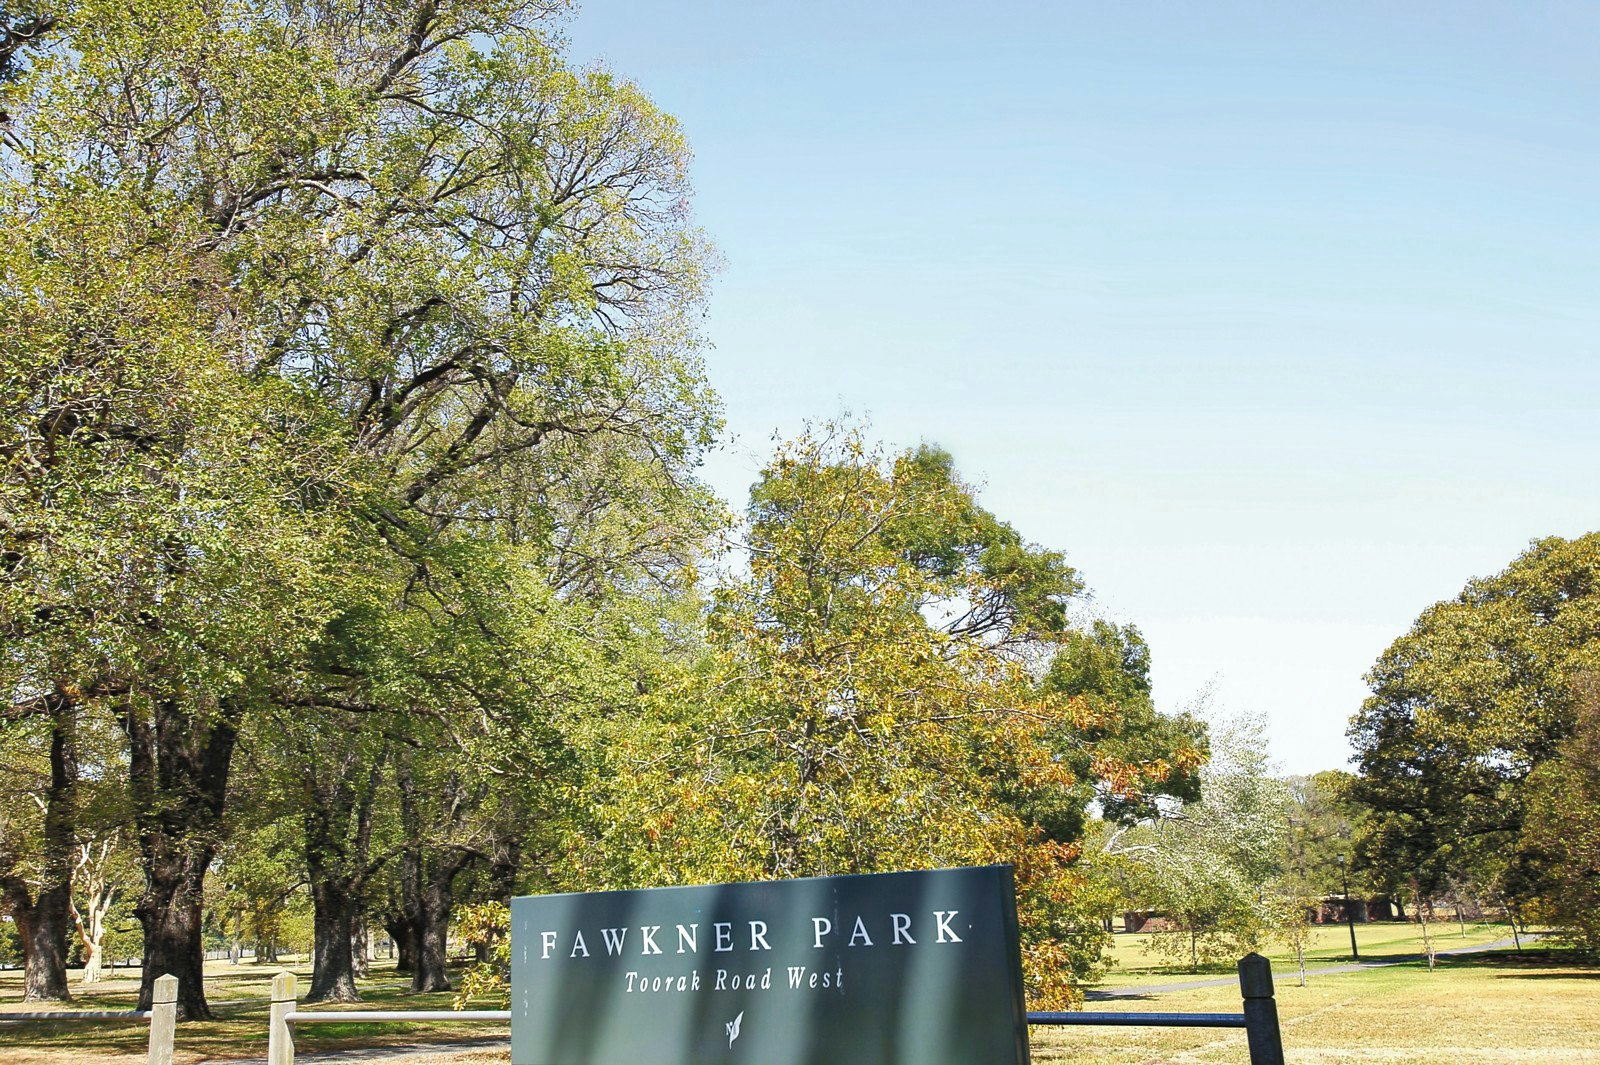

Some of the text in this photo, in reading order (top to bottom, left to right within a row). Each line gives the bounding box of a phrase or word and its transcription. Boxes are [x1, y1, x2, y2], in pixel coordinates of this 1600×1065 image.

[541, 910, 964, 959] FAWKNER PARK
[625, 966, 844, 993] Toorak Road West
